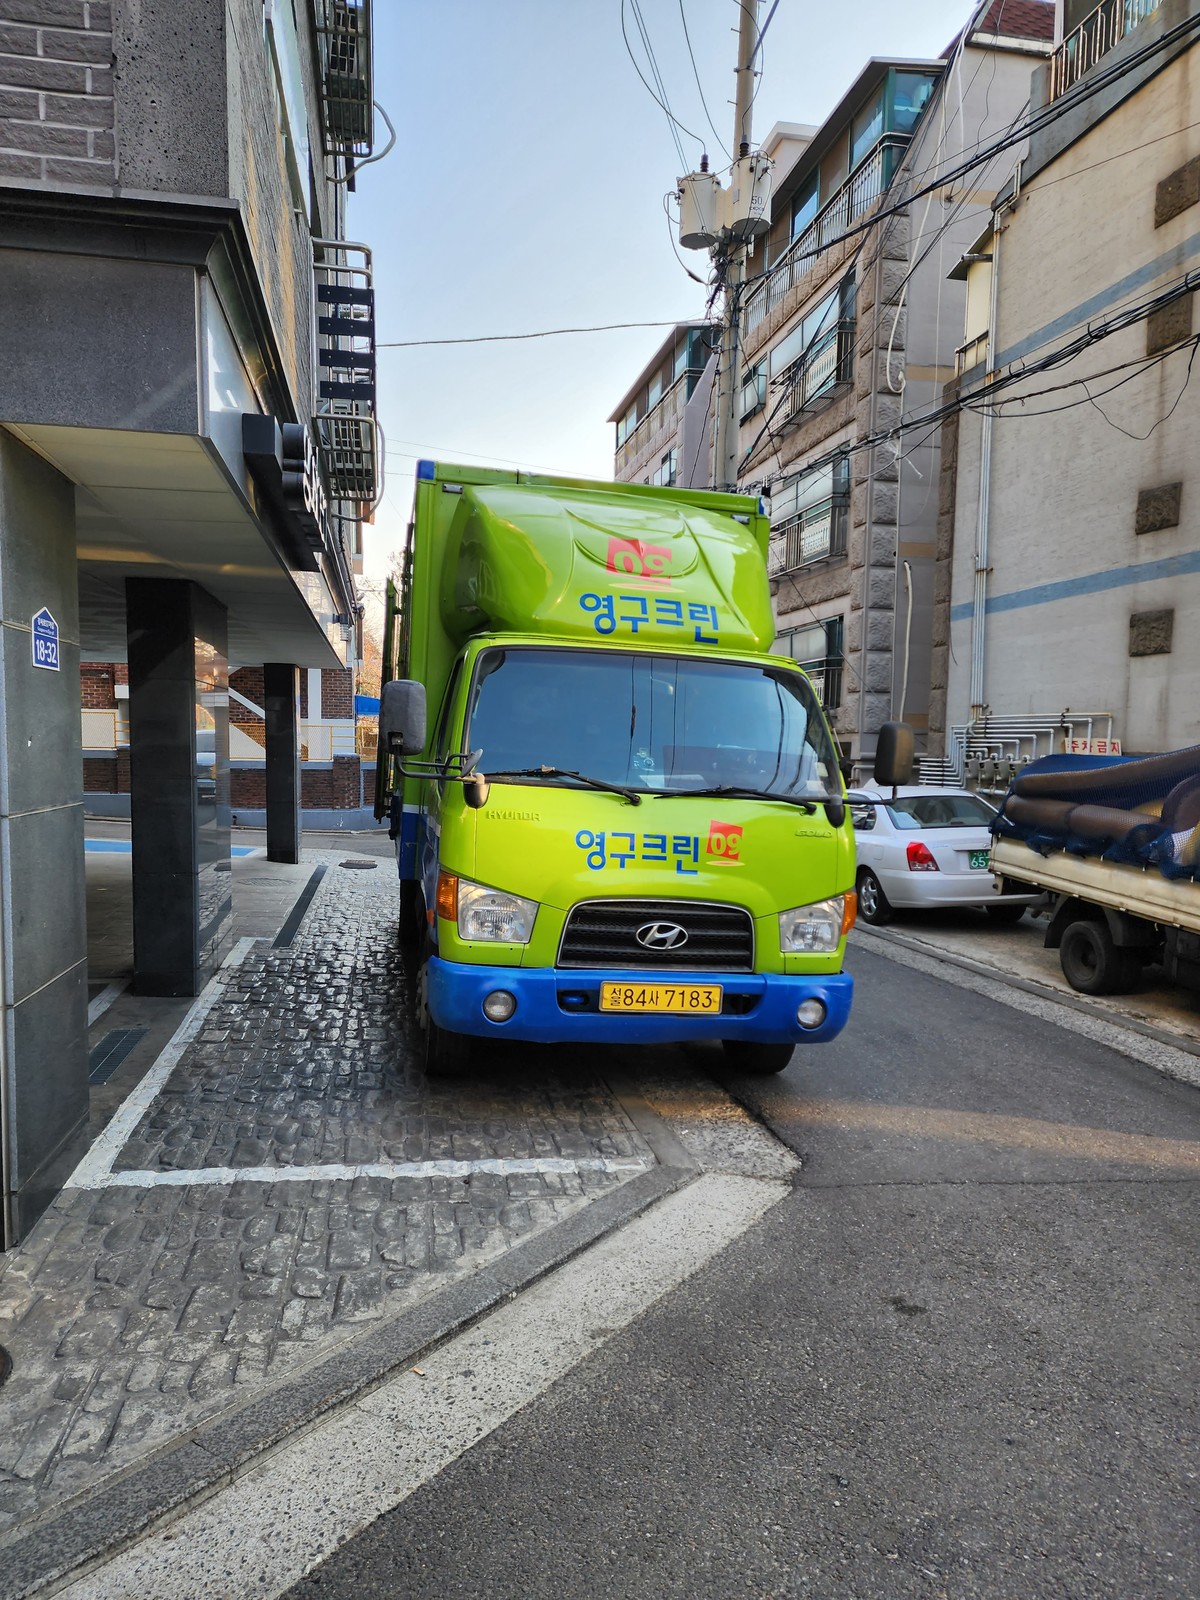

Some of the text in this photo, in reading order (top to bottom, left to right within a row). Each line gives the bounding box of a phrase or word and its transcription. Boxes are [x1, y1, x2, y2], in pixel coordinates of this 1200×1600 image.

[613, 551, 672, 577] 09
[579, 592, 719, 644] 영구크린
[36, 639, 57, 664] 18-32
[575, 829, 739, 875] 영구크린 09
[664, 989, 713, 1008] 7183
